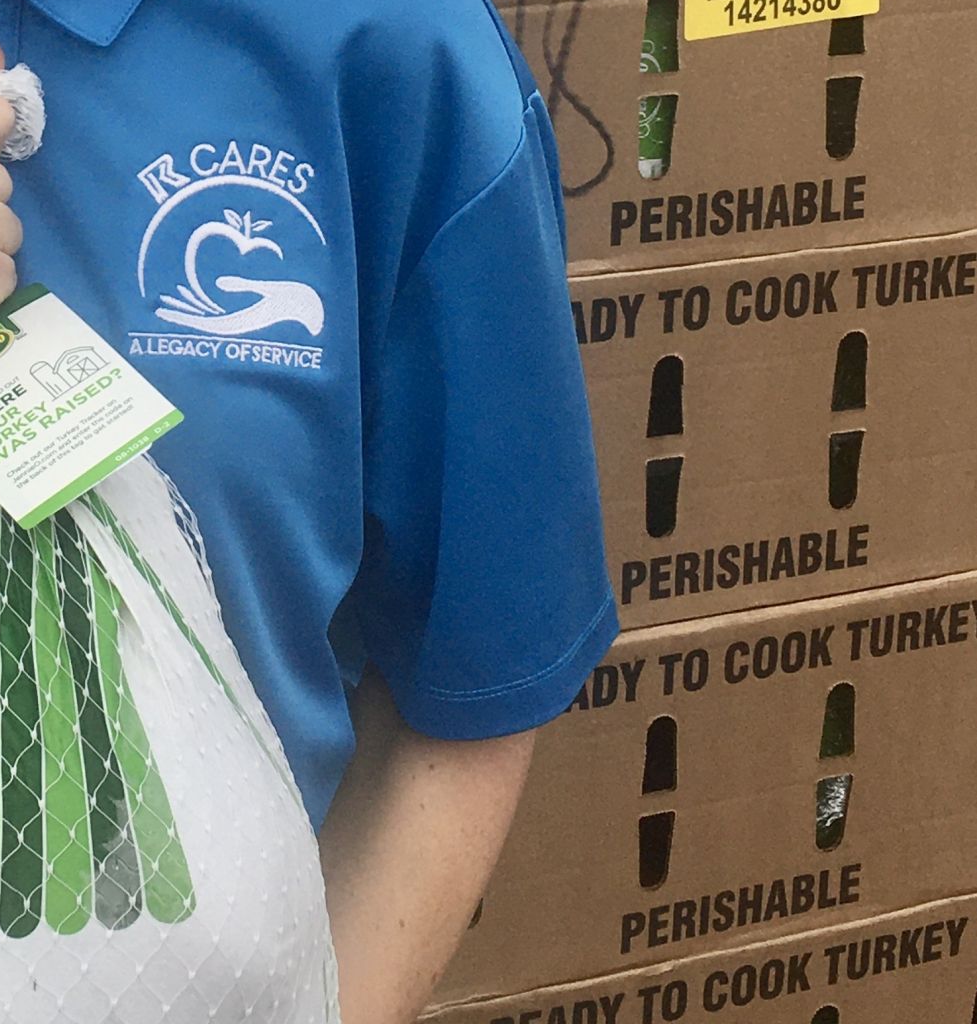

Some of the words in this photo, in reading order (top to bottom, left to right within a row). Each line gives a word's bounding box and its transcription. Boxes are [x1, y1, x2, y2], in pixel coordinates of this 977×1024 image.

[190, 140, 315, 194] CARES
[610, 175, 866, 246] PERISHABLE
[658, 285, 710, 333] TO
[725, 270, 838, 326] COOK
[852, 252, 977, 310] TURKE
[129, 338, 145, 355] A
[147, 339, 221, 358] LEGACY
[225, 343, 252, 362] OF
[252, 346, 323, 369] SERVICE
[40, 367, 122, 428] RAISED?
[621, 524, 870, 605] PERISHABLE
[658, 649, 710, 695] TO
[723, 625, 836, 684] COOK
[846, 600, 977, 661] TURKE
[620, 863, 862, 954] PERISHABLE
[638, 979, 688, 1024] TO
[702, 953, 812, 1013] COOK
[824, 917, 969, 985] TURKEY
